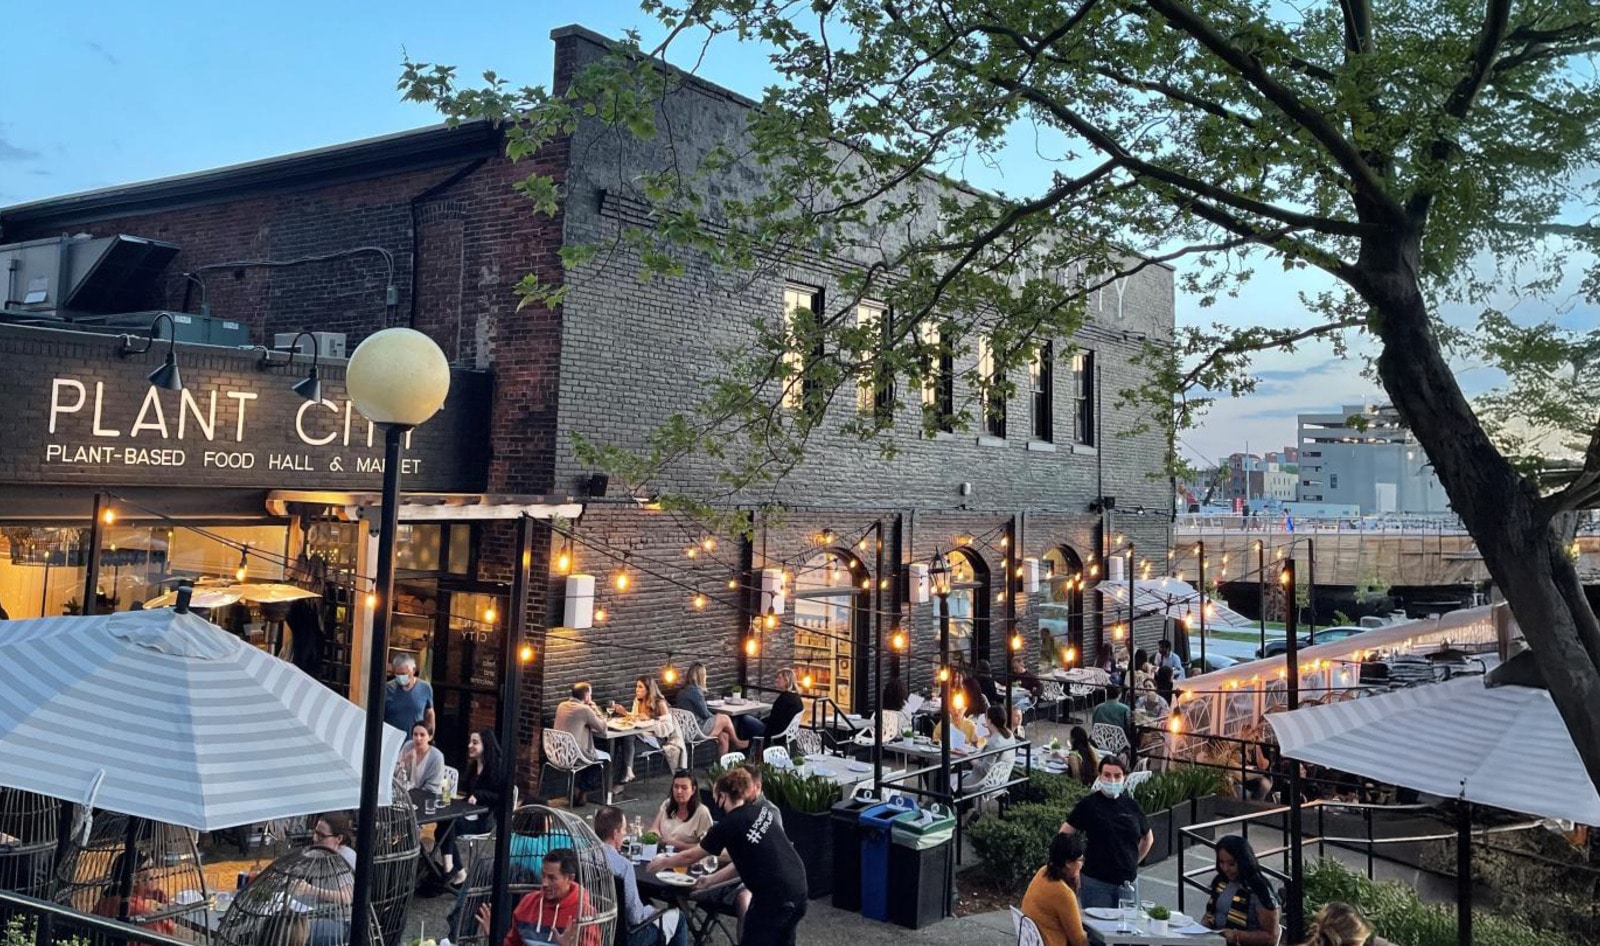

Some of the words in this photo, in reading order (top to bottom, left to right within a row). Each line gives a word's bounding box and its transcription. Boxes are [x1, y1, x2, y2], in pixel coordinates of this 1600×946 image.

[48, 377, 258, 443] PLANT
[45, 444, 186, 467] PLANT-BASED
[203, 451, 255, 469] FOOD
[268, 453, 315, 471] HALL
[329, 456, 344, 472] &
[356, 457, 422, 475] MAET
